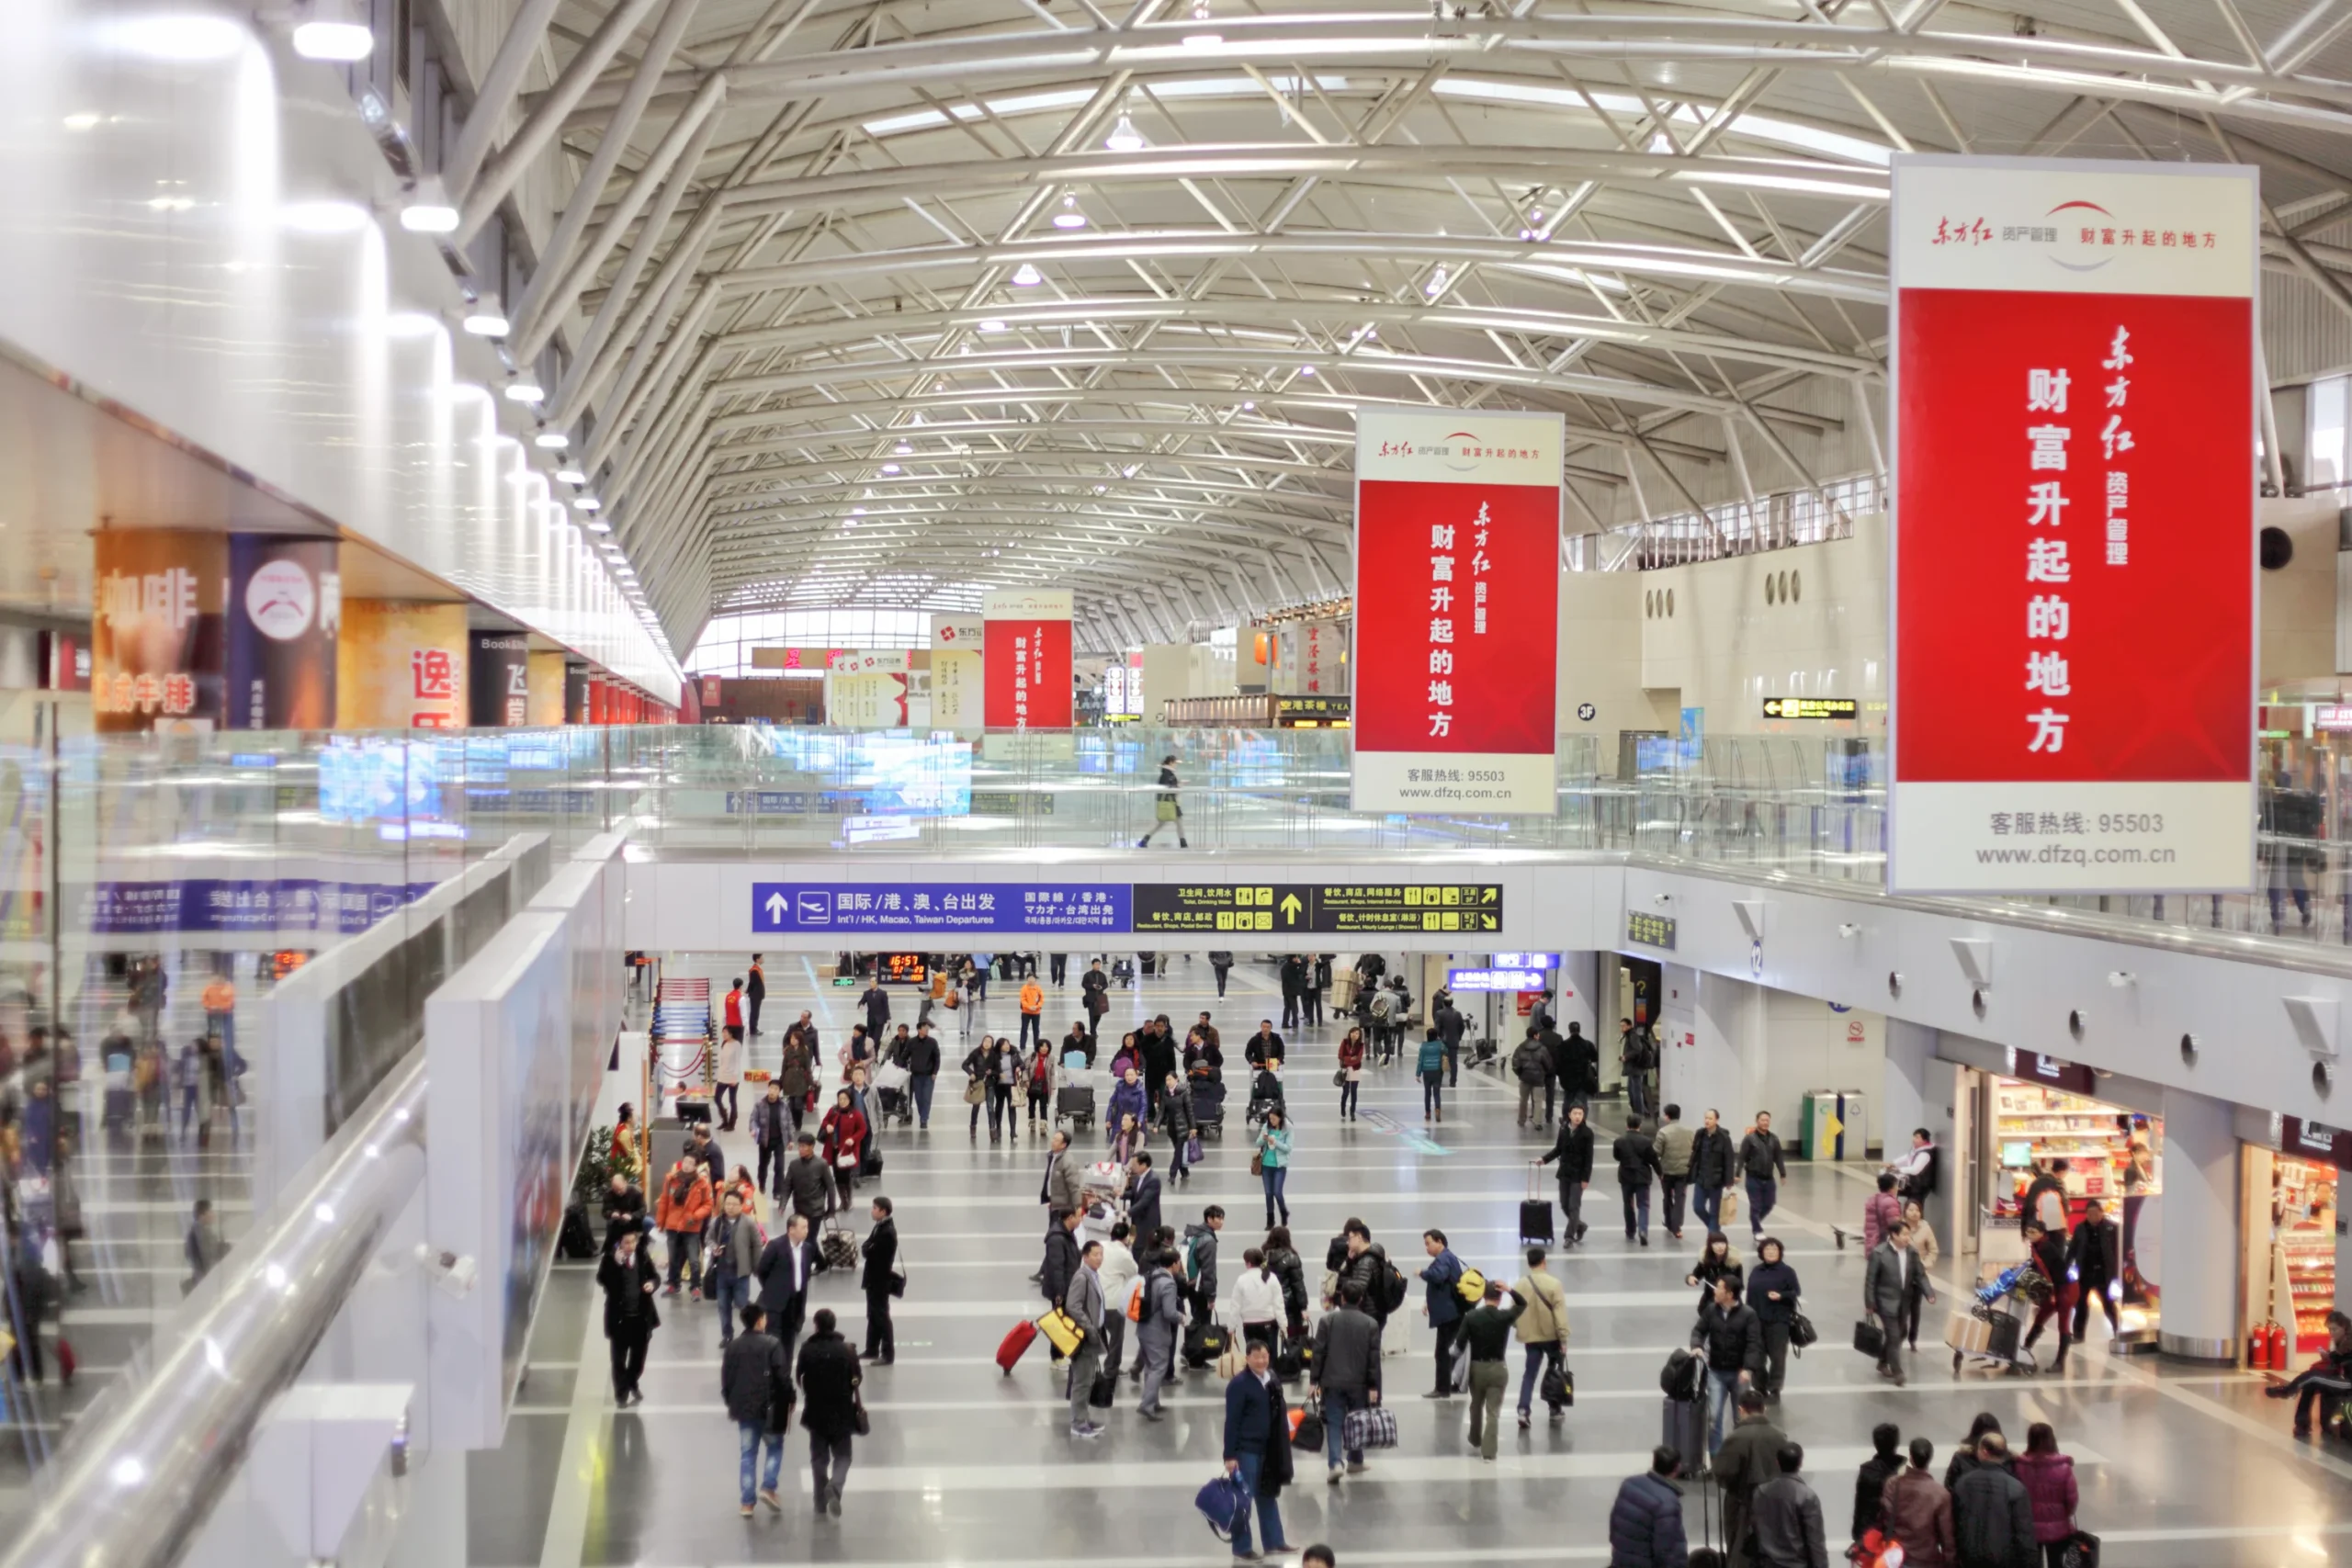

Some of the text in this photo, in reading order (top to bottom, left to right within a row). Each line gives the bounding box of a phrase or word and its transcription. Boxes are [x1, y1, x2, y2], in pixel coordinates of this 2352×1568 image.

[1932, 215, 2217, 249] 东方红 资产管理 财富升起的地方
[1378, 441, 1413, 457] 东方红
[1462, 447, 1540, 459] 财富升起的地方
[2100, 324, 2135, 565] 东方红 资产管理
[1472, 501, 1491, 576] 东方红
[2025, 367, 2072, 753] 财富升起的地方
[95, 568, 198, 628] 咖啡
[1428, 525, 1455, 738] 财富升起的地方
[1580, 705, 1593, 717] 3F
[1408, 769, 1505, 782] 客服热线: 95503
[1399, 786, 1512, 800] www.dfzq.com.cn
[1990, 812, 2165, 835] 客服热线: 95503
[1975, 843, 2177, 867] www.dfzq.com.cn
[1178, 888, 1232, 897] 卫生间、饮用水
[837, 893, 996, 911] 国际/港、澳、台出发
[880, 915, 912, 925] Macao,
[914, 915, 944, 924] Taiwan
[946, 915, 994, 926] Departures
[891, 955, 918, 965] 16:57
[914, 965, 924, 974] 20
